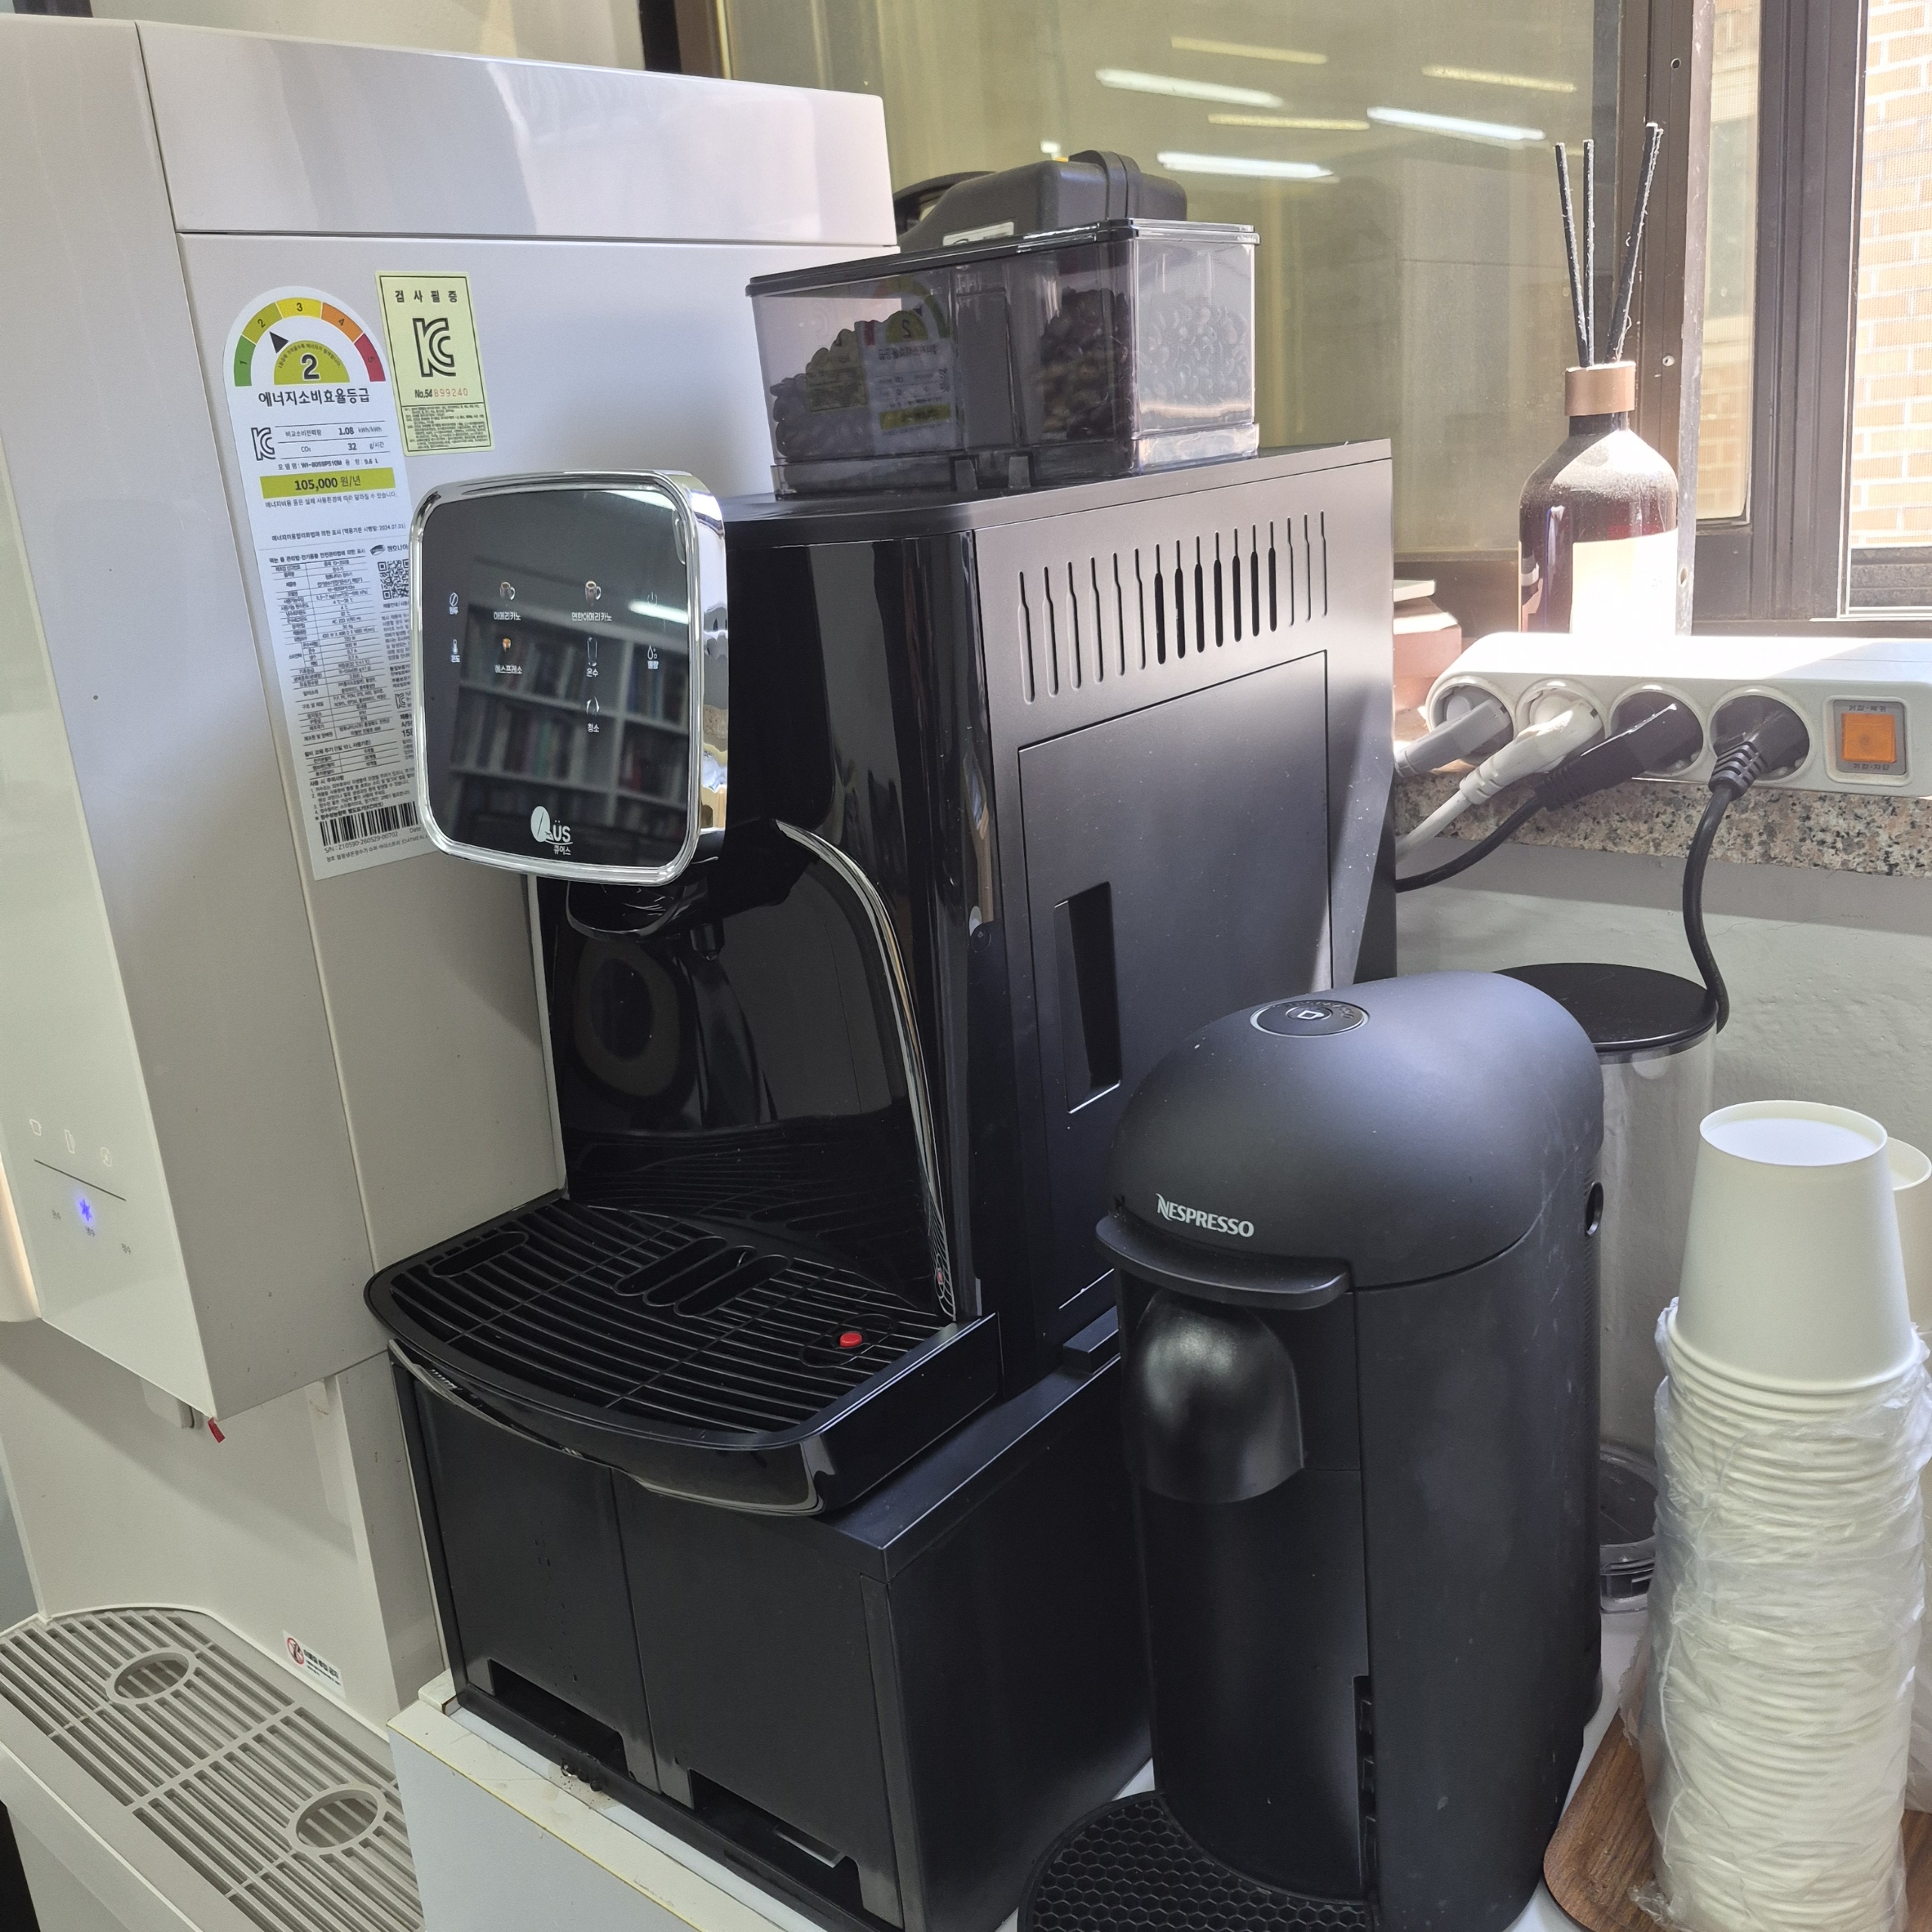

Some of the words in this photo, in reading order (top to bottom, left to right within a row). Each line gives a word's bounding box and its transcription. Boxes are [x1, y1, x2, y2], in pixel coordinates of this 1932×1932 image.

[296, 303, 303, 312] 3
[257, 318, 266, 328] 2
[301, 354, 320, 380] 2
[258, 388, 370, 407] 에너지소비효율등급
[338, 426, 355, 435] 1.08
[347, 442, 357, 451] 32
[294, 477, 338, 491] 105,000
[340, 475, 361, 487] 원/년
[494, 611, 521, 620] 아메리카노
[571, 612, 612, 622] 연한아메리카노
[494, 665, 523, 674] 에스프레소
[586, 668, 598, 678] 온수
[587, 723, 600, 733] 청소
[553, 845, 571, 856] 큐이스
[1155, 1193, 1254, 1237] NESPRESSO
